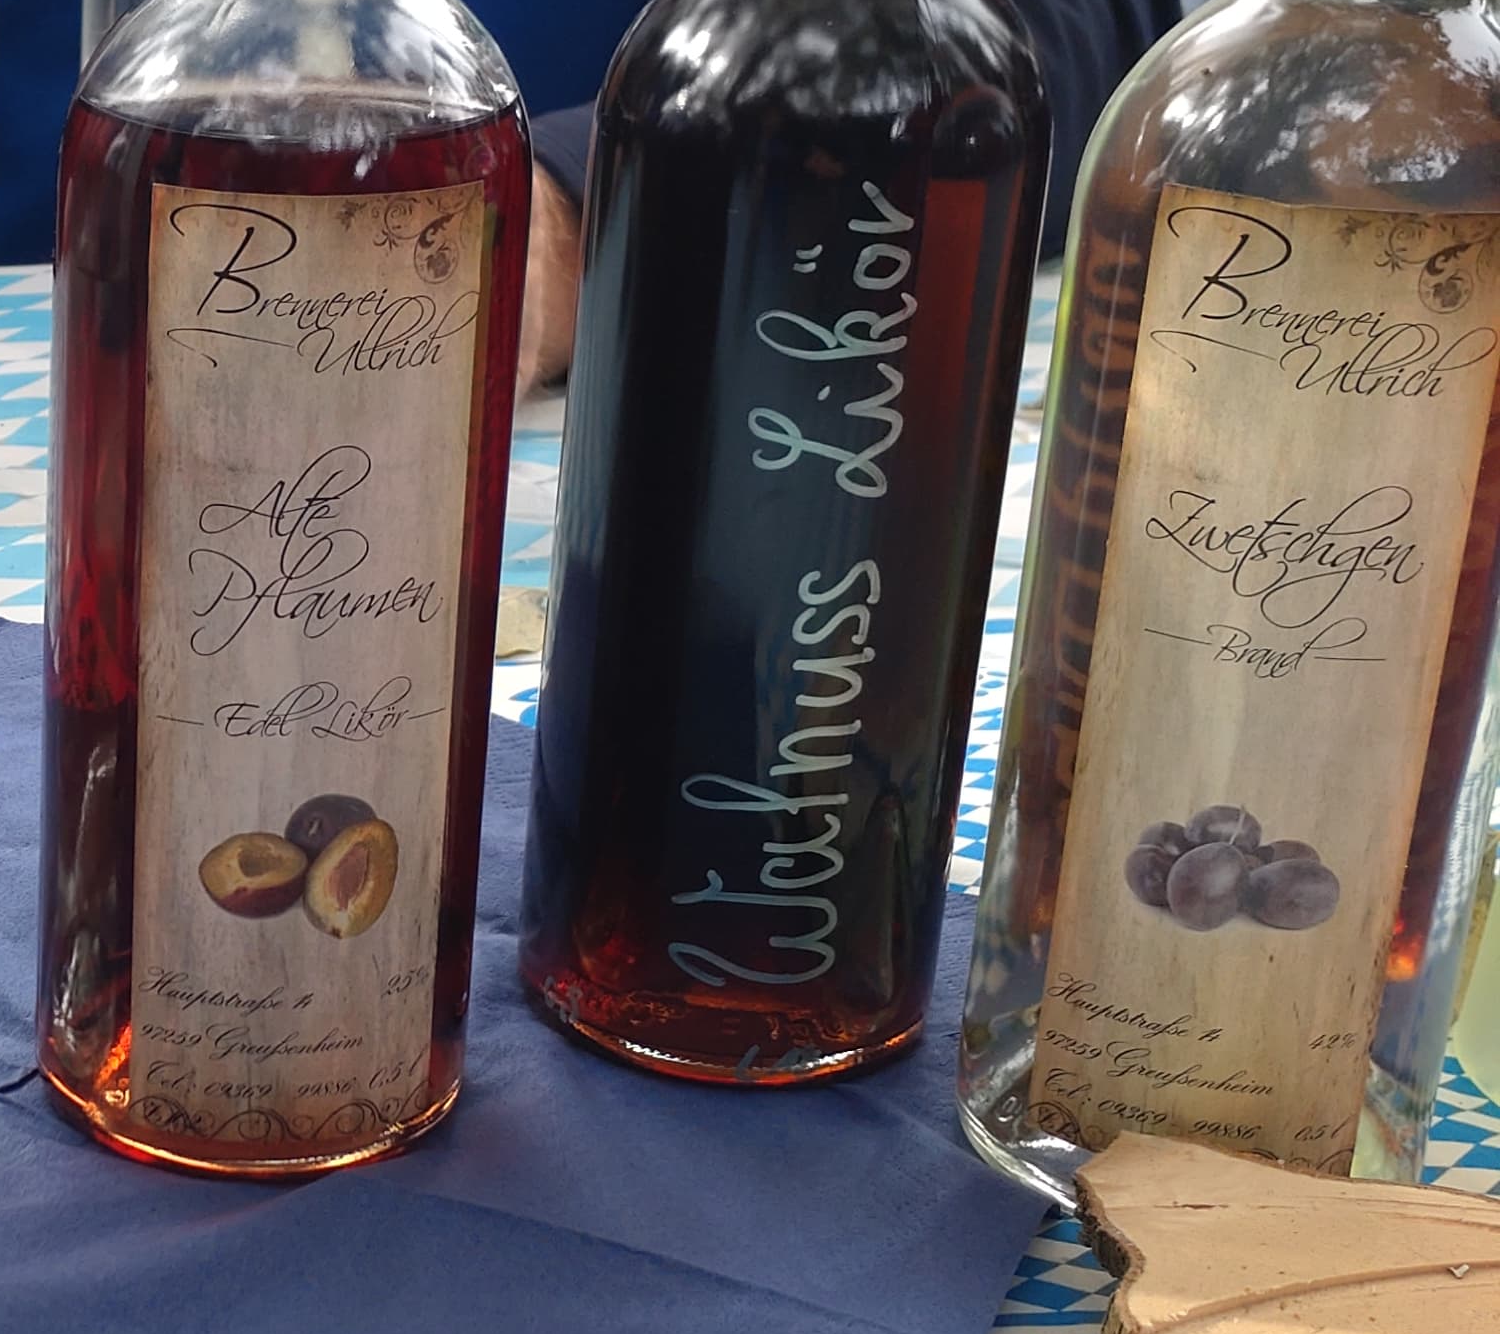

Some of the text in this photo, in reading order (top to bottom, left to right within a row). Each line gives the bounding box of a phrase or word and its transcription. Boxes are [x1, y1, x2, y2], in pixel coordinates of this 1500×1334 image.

[169, 203, 387, 332] Brennerei
[1167, 205, 1387, 346] Brennerei
[296, 291, 482, 376] Ullrich
[748, 179, 918, 499] Likör
[1279, 321, 1499, 399] Ullrich
[199, 445, 372, 572] Alte
[1145, 485, 1425, 630] Zwetschgen
[189, 530, 444, 656] Pflaumen
[214, 681, 339, 739] Edel
[1041, 1028, 1104, 1062] 97259
[1096, 1098, 1169, 1127] 09369
[1191, 1118, 1264, 1141] 99886
